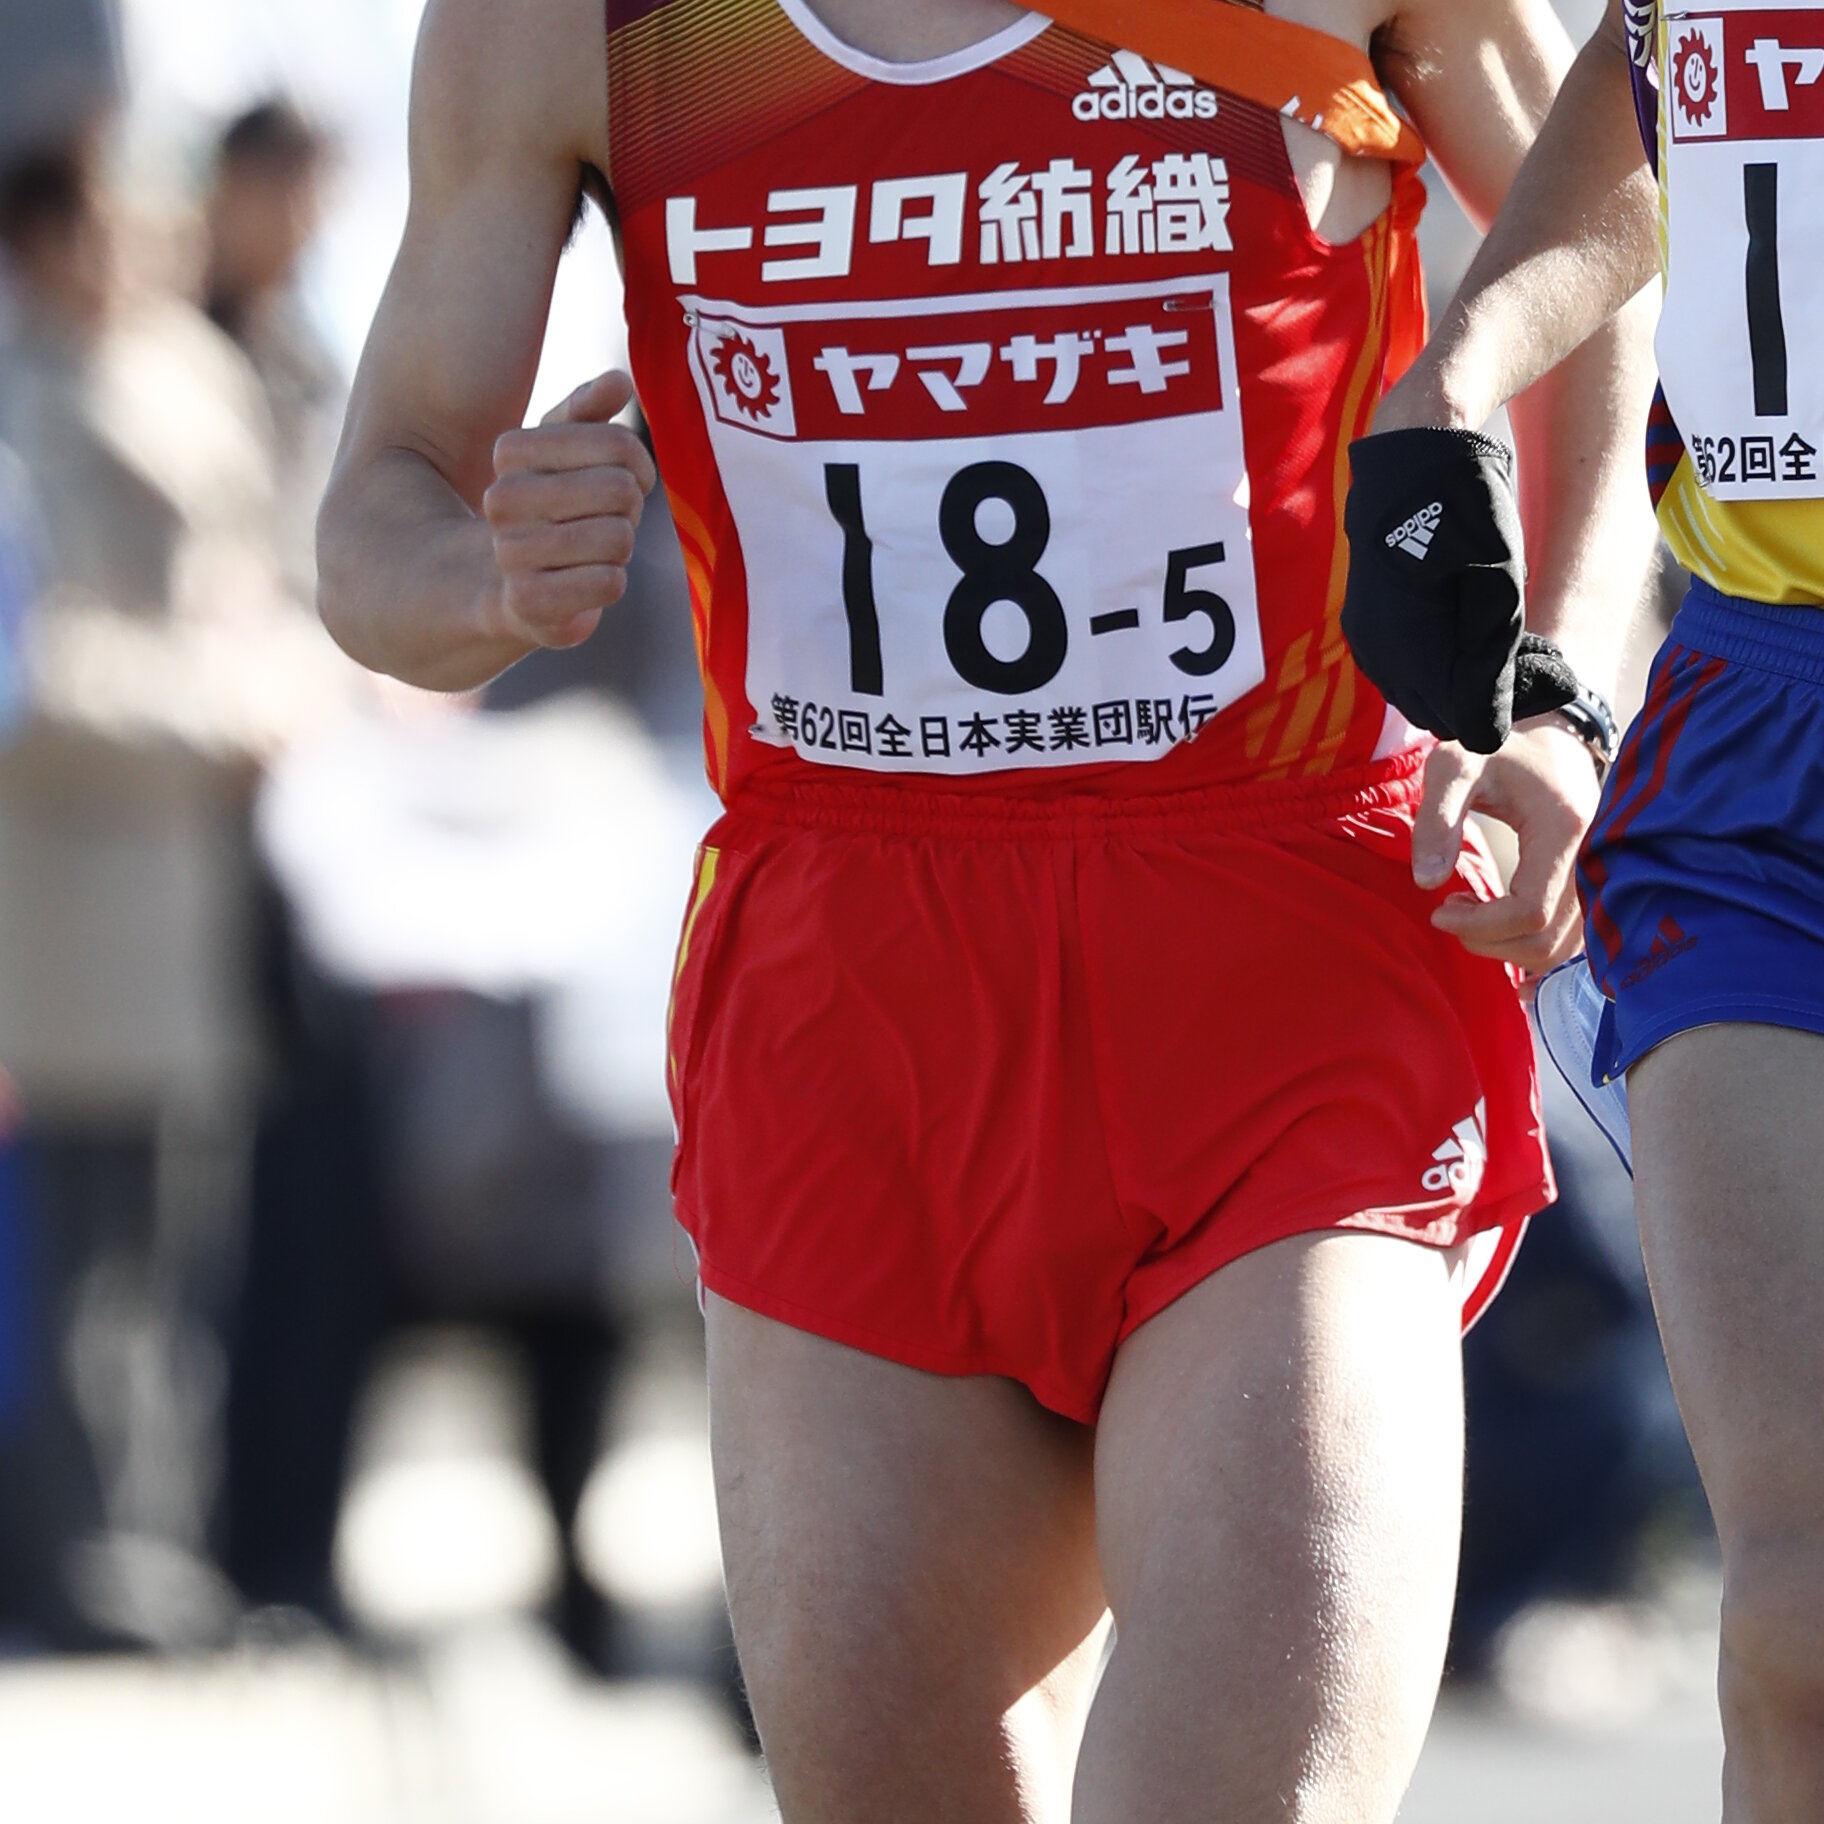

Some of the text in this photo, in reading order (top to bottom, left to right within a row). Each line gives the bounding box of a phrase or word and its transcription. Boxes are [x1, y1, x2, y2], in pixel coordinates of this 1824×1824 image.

[1072, 84, 1218, 121] adidas
[666, 152, 1234, 285] トヨタ紡織
[813, 323, 1191, 415] ヤマザキ
[1385, 501, 1443, 548] adidas
[823, 459, 1236, 696] 18-5
[771, 692, 1219, 759] 第62回全日本実業団駅伝
